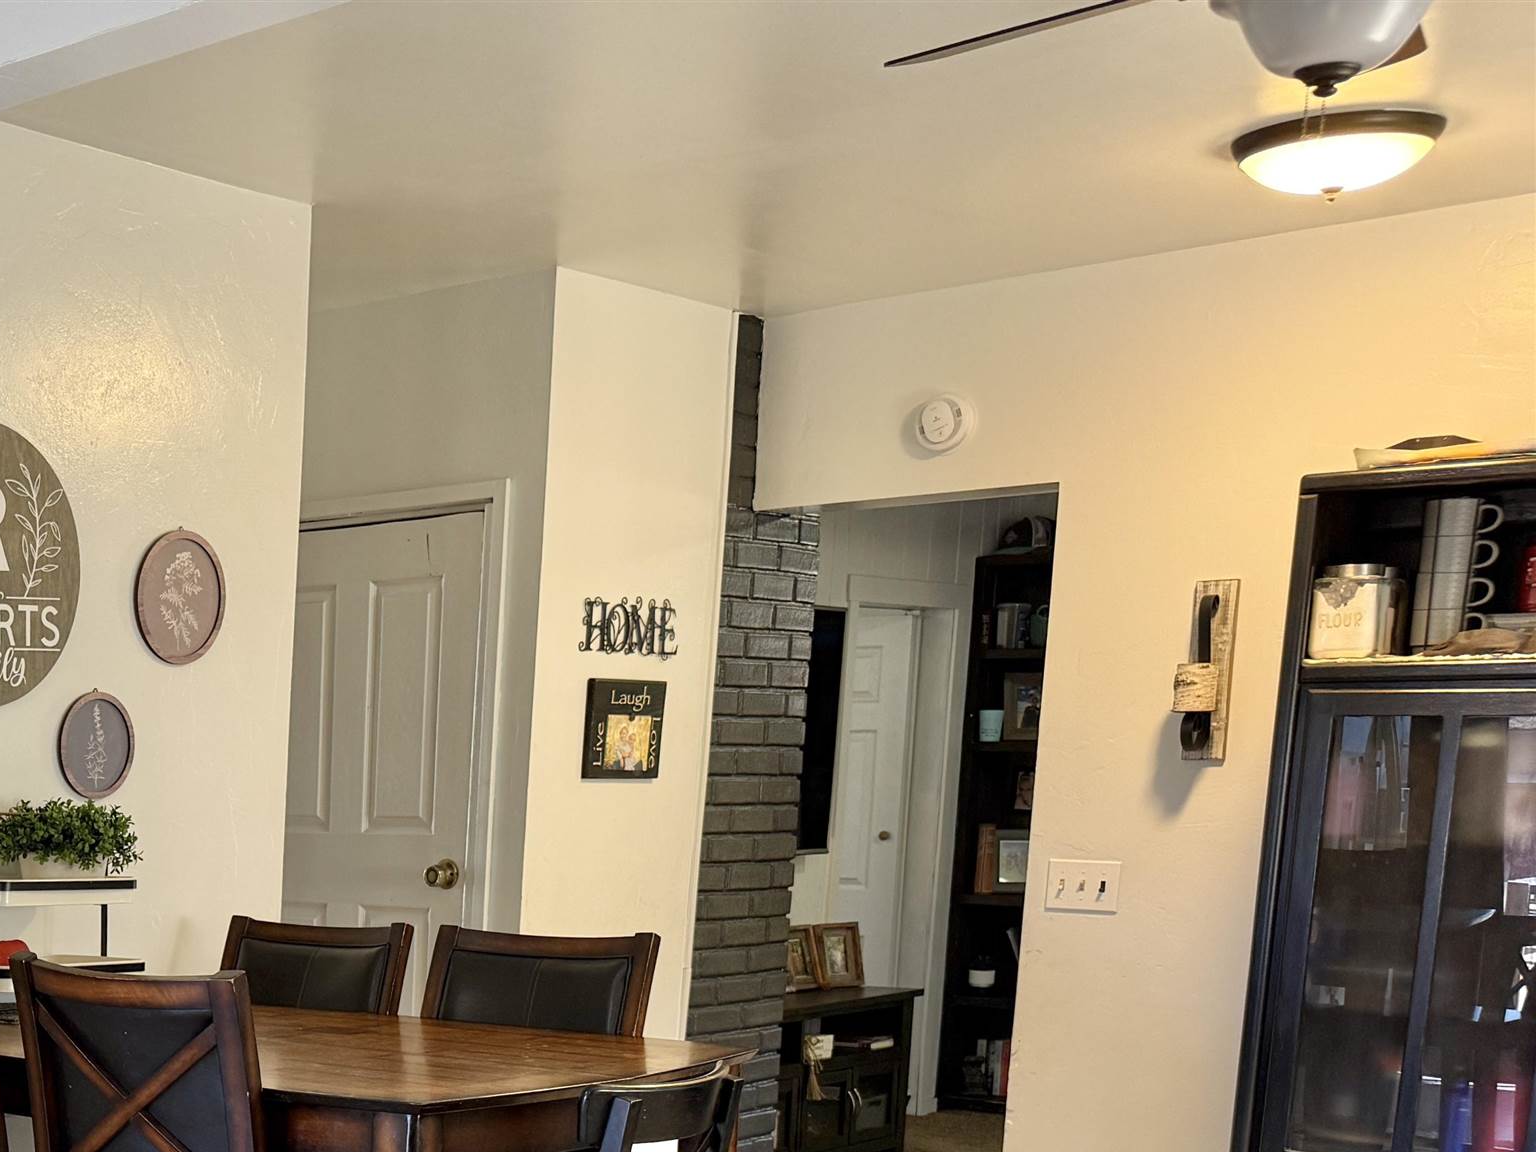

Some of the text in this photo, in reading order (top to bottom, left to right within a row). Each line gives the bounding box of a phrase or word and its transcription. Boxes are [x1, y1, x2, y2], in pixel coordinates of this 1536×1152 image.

[578, 596, 679, 662] HOME
[1317, 611, 1364, 629] FLOUR
[611, 686, 651, 712] Laugh
[592, 722, 605, 767] Live
[648, 717, 662, 769] Love
